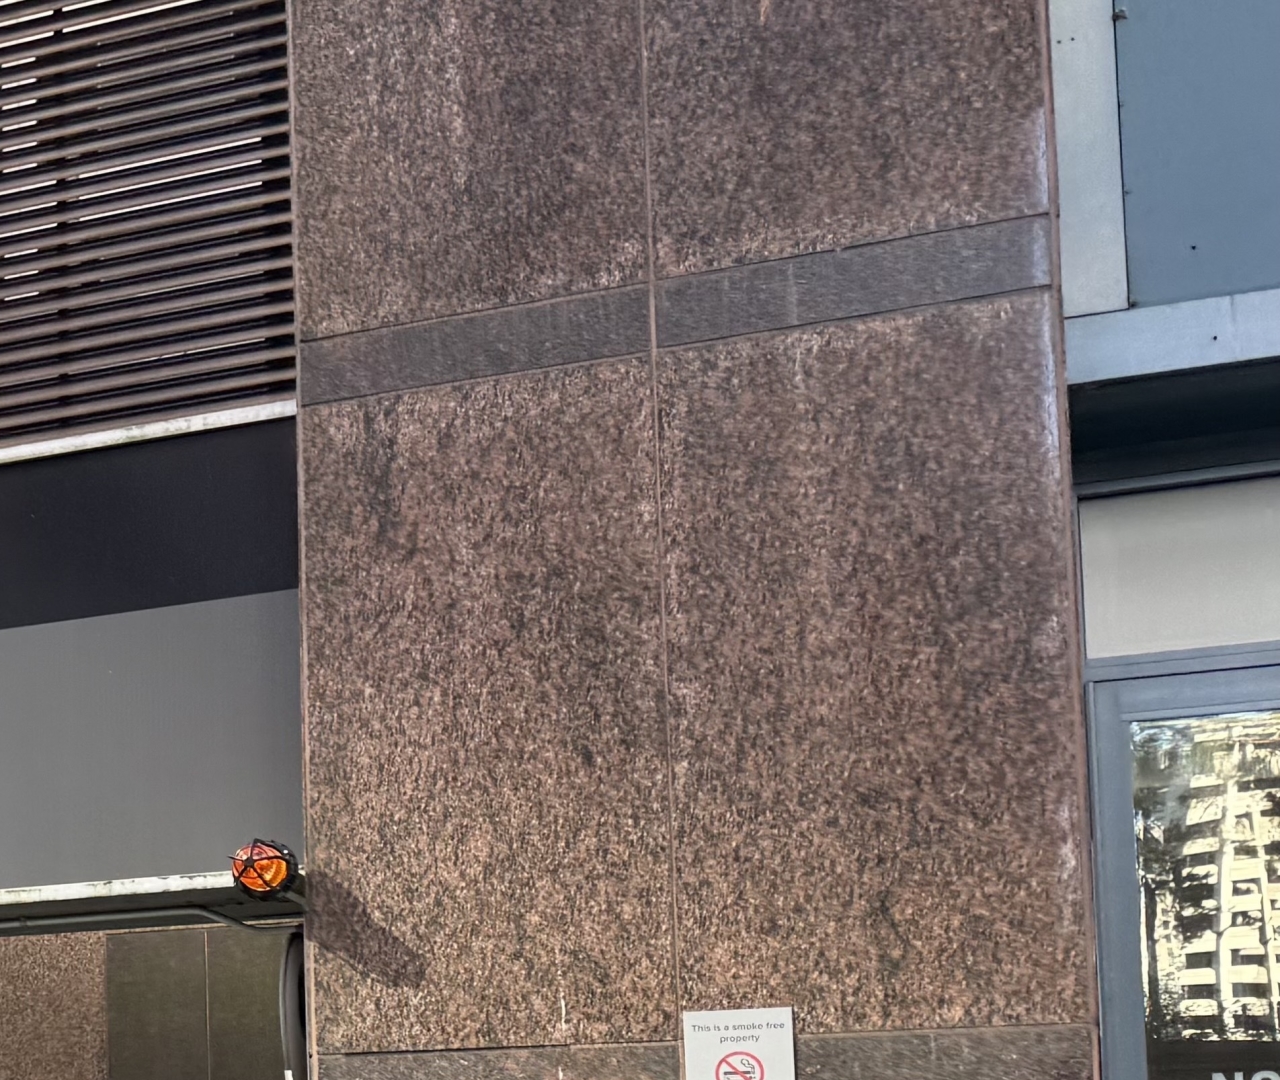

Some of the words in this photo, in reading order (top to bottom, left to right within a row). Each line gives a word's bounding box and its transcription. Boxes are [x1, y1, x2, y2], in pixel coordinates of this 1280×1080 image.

[691, 1024, 711, 1032] This
[732, 1022, 763, 1031] smoke
[720, 1034, 760, 1044] property
